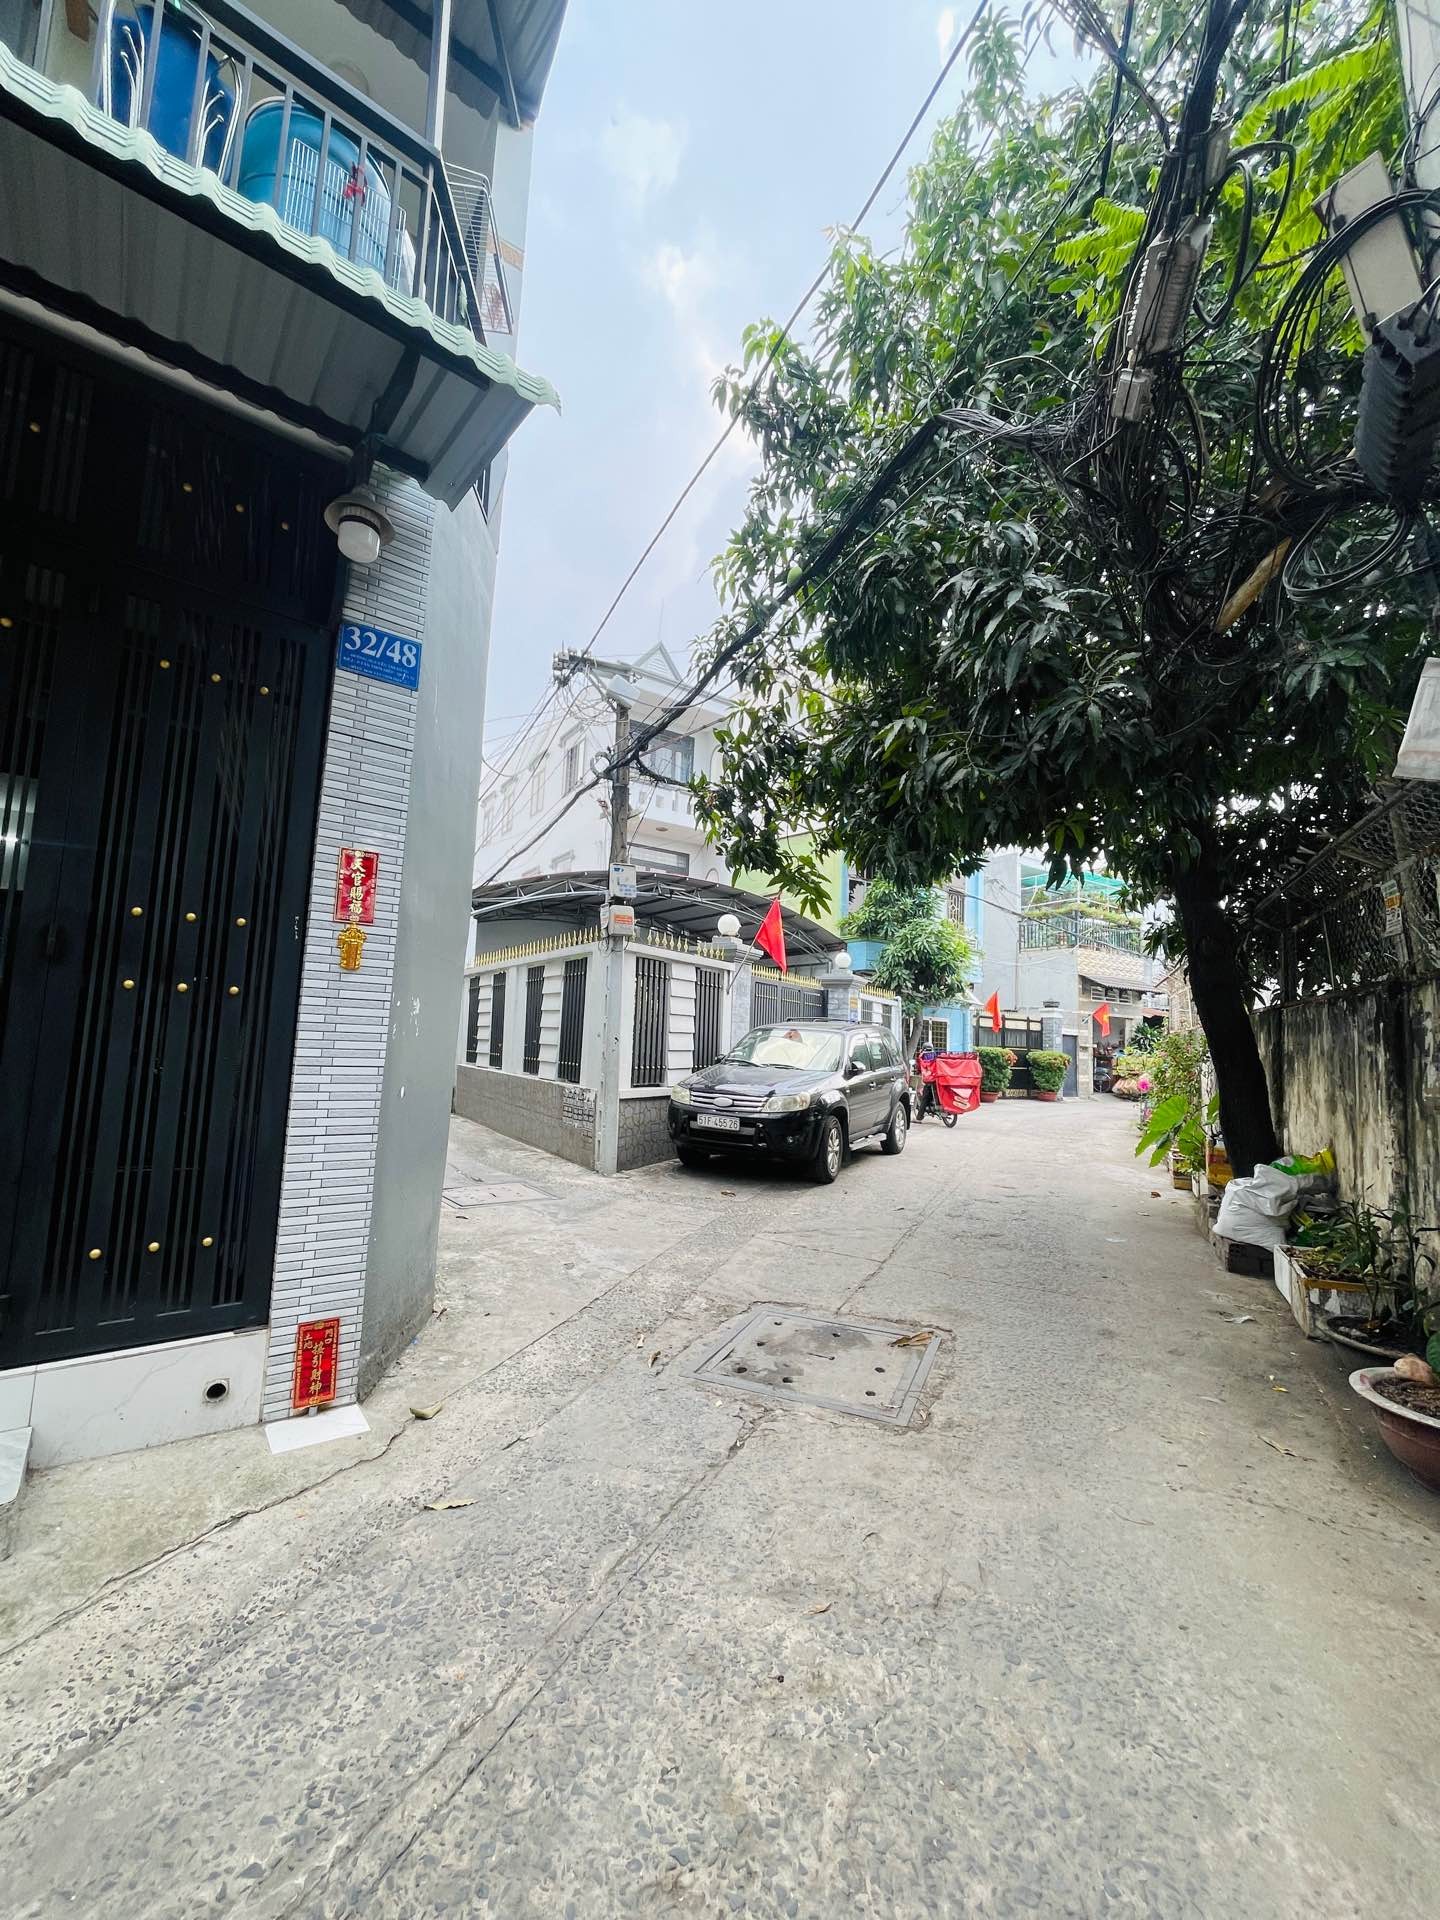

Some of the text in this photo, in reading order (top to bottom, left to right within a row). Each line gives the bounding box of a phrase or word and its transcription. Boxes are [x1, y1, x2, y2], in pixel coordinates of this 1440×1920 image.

[344, 626, 416, 668] 32/48
[348, 858, 366, 914] 天官賜福
[699, 1115, 711, 1125] 51F
[729, 1119, 738, 1129] 26
[303, 1333, 313, 1349] 土地
